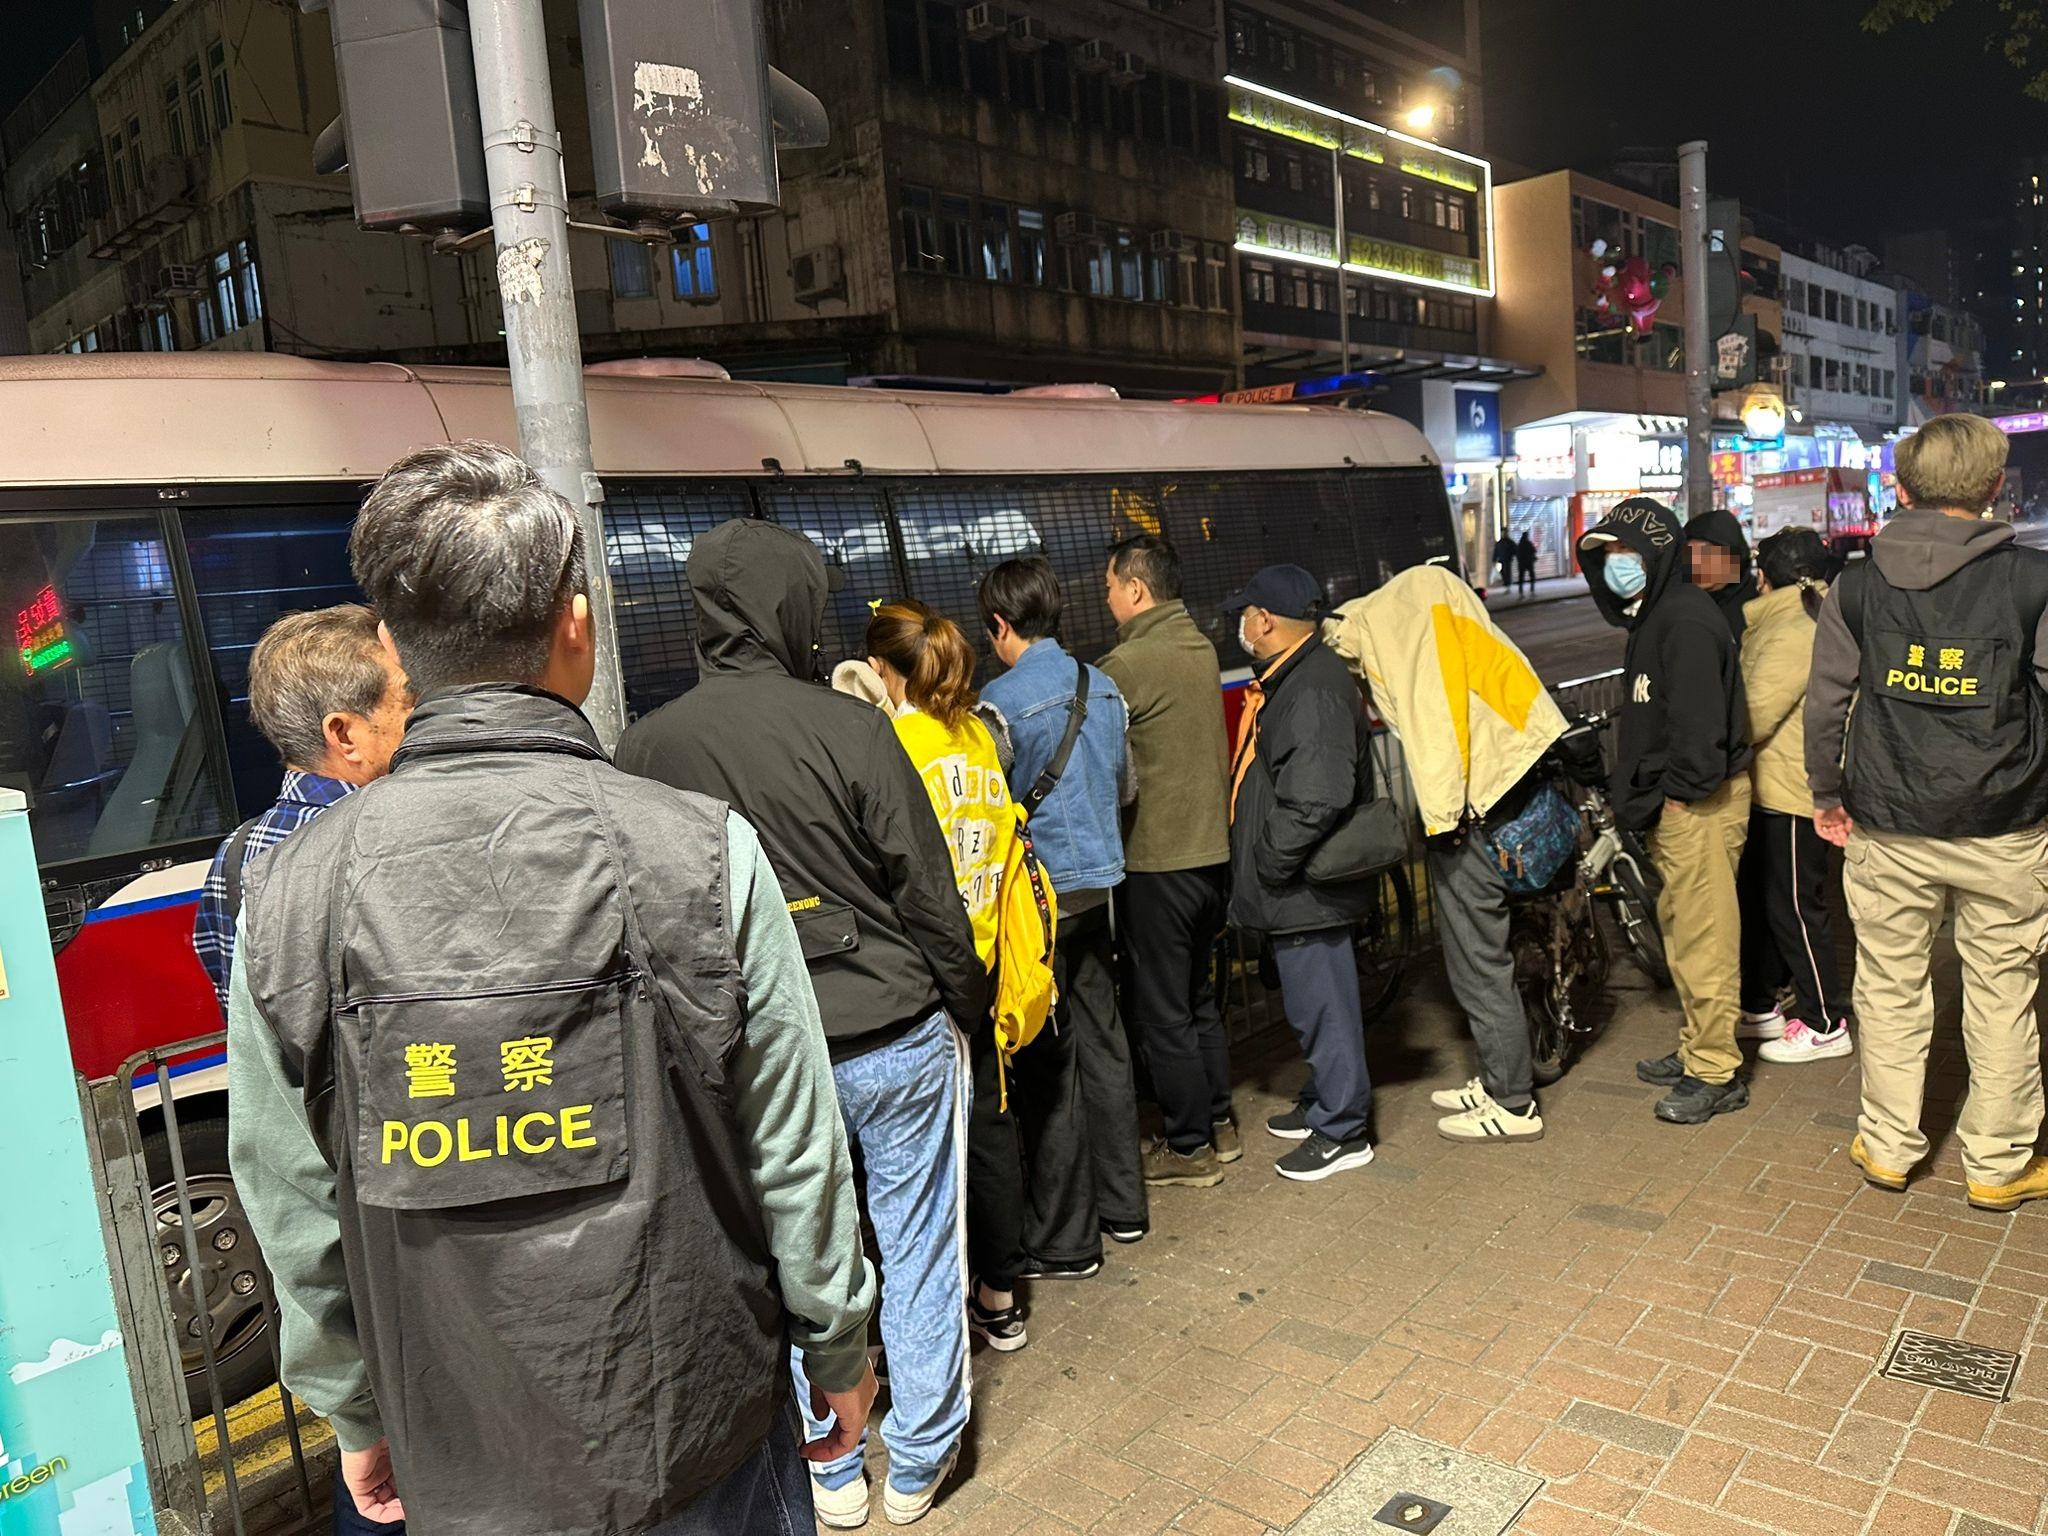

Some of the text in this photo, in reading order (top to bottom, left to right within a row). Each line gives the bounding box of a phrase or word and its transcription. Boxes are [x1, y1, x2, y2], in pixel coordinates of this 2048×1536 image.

[1237, 388, 1276, 404] POLICE
[1907, 644, 1965, 670] 警察
[1886, 669, 1978, 695] POLICE
[404, 1036, 555, 1098] 警察
[381, 1104, 598, 1168] POLICE
[0, 1456, 68, 1500] reen
